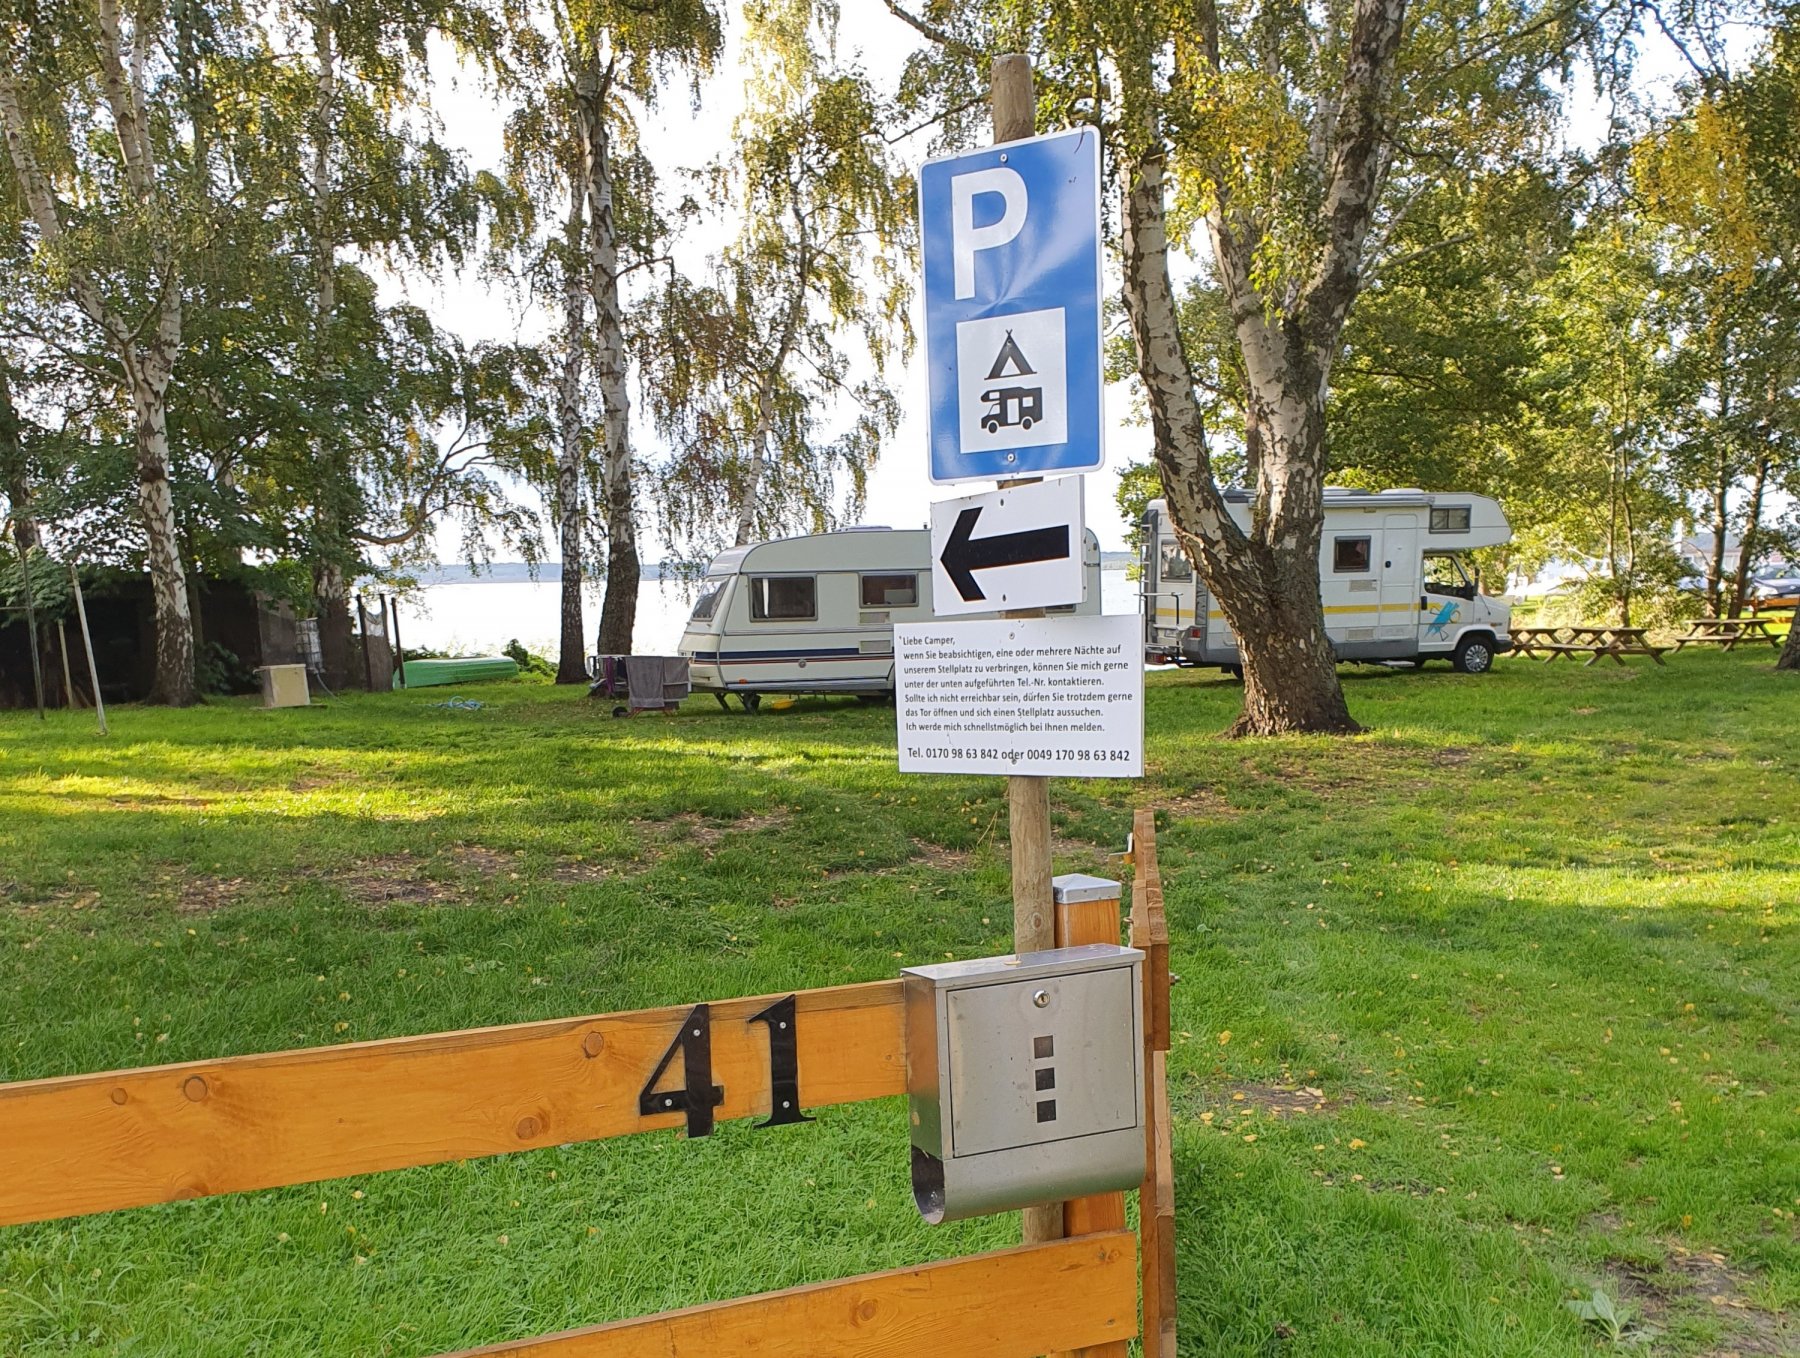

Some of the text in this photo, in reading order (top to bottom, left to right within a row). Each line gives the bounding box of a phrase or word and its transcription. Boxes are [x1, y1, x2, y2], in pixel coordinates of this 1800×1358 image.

[951, 167, 1028, 300] P
[903, 636, 955, 646] Liebe Camper,
[926, 651, 936, 659] Sie
[939, 649, 994, 660] beabsichtigen,
[996, 649, 1013, 657] eine
[1016, 647, 1034, 657] oder
[1037, 647, 1072, 656] mehrere
[1074, 646, 1104, 655] Nächte
[1107, 644, 1121, 654] auf
[938, 664, 972, 675] Stellplatz
[985, 663, 1031, 674] verbringen,
[1033, 662, 1063, 671] können
[1066, 662, 1078, 671] Sie
[1081, 661, 1101, 670] mich
[1104, 662, 1128, 672] gerne
[926, 679, 938, 688] der
[941, 680, 962, 688] unten
[965, 678, 1015, 689] aufgeführten
[1017, 678, 1045, 686] Tel.-Nr.
[1048, 677, 1104, 686] kontaktieren.
[905, 692, 1132, 703] Sollte ich nicht erreichbar sein, dürfen Sie trotzdem gerne
[906, 708, 1103, 718] das Tor öffnen und sich einen Stellplatz aussuchen.
[906, 722, 1104, 733] Ich werde mich schnellstmöglich bei Ihnen melden.
[907, 747, 1130, 761] Tel. 0170 98 63 842 oder 0049 170 98 63 842
[640, 994, 817, 1138] 41
